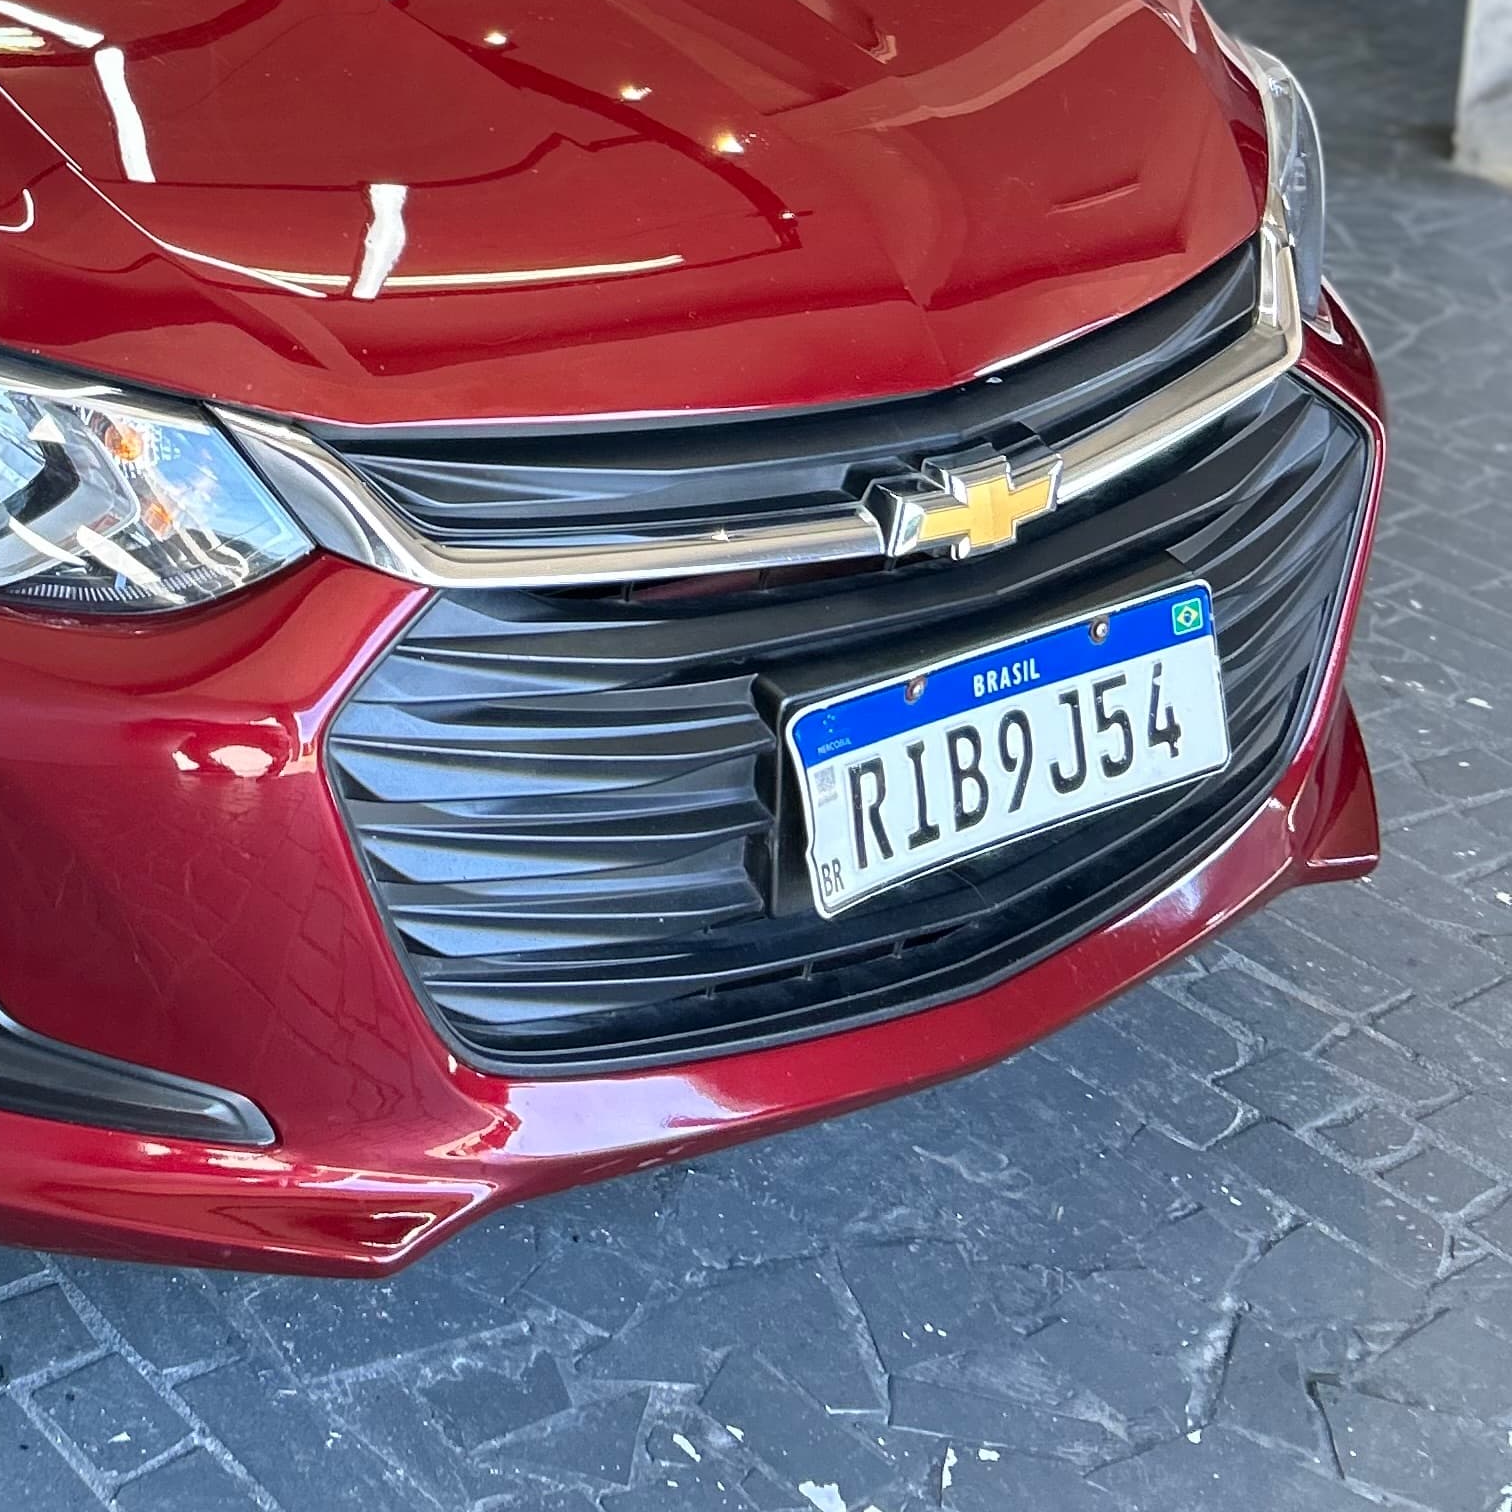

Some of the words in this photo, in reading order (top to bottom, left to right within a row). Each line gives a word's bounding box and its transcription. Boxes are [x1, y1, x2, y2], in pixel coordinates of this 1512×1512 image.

[973, 658, 1041, 698] BRASIL
[848, 661, 1182, 870] RIB9J54
[821, 858, 845, 897] BR
